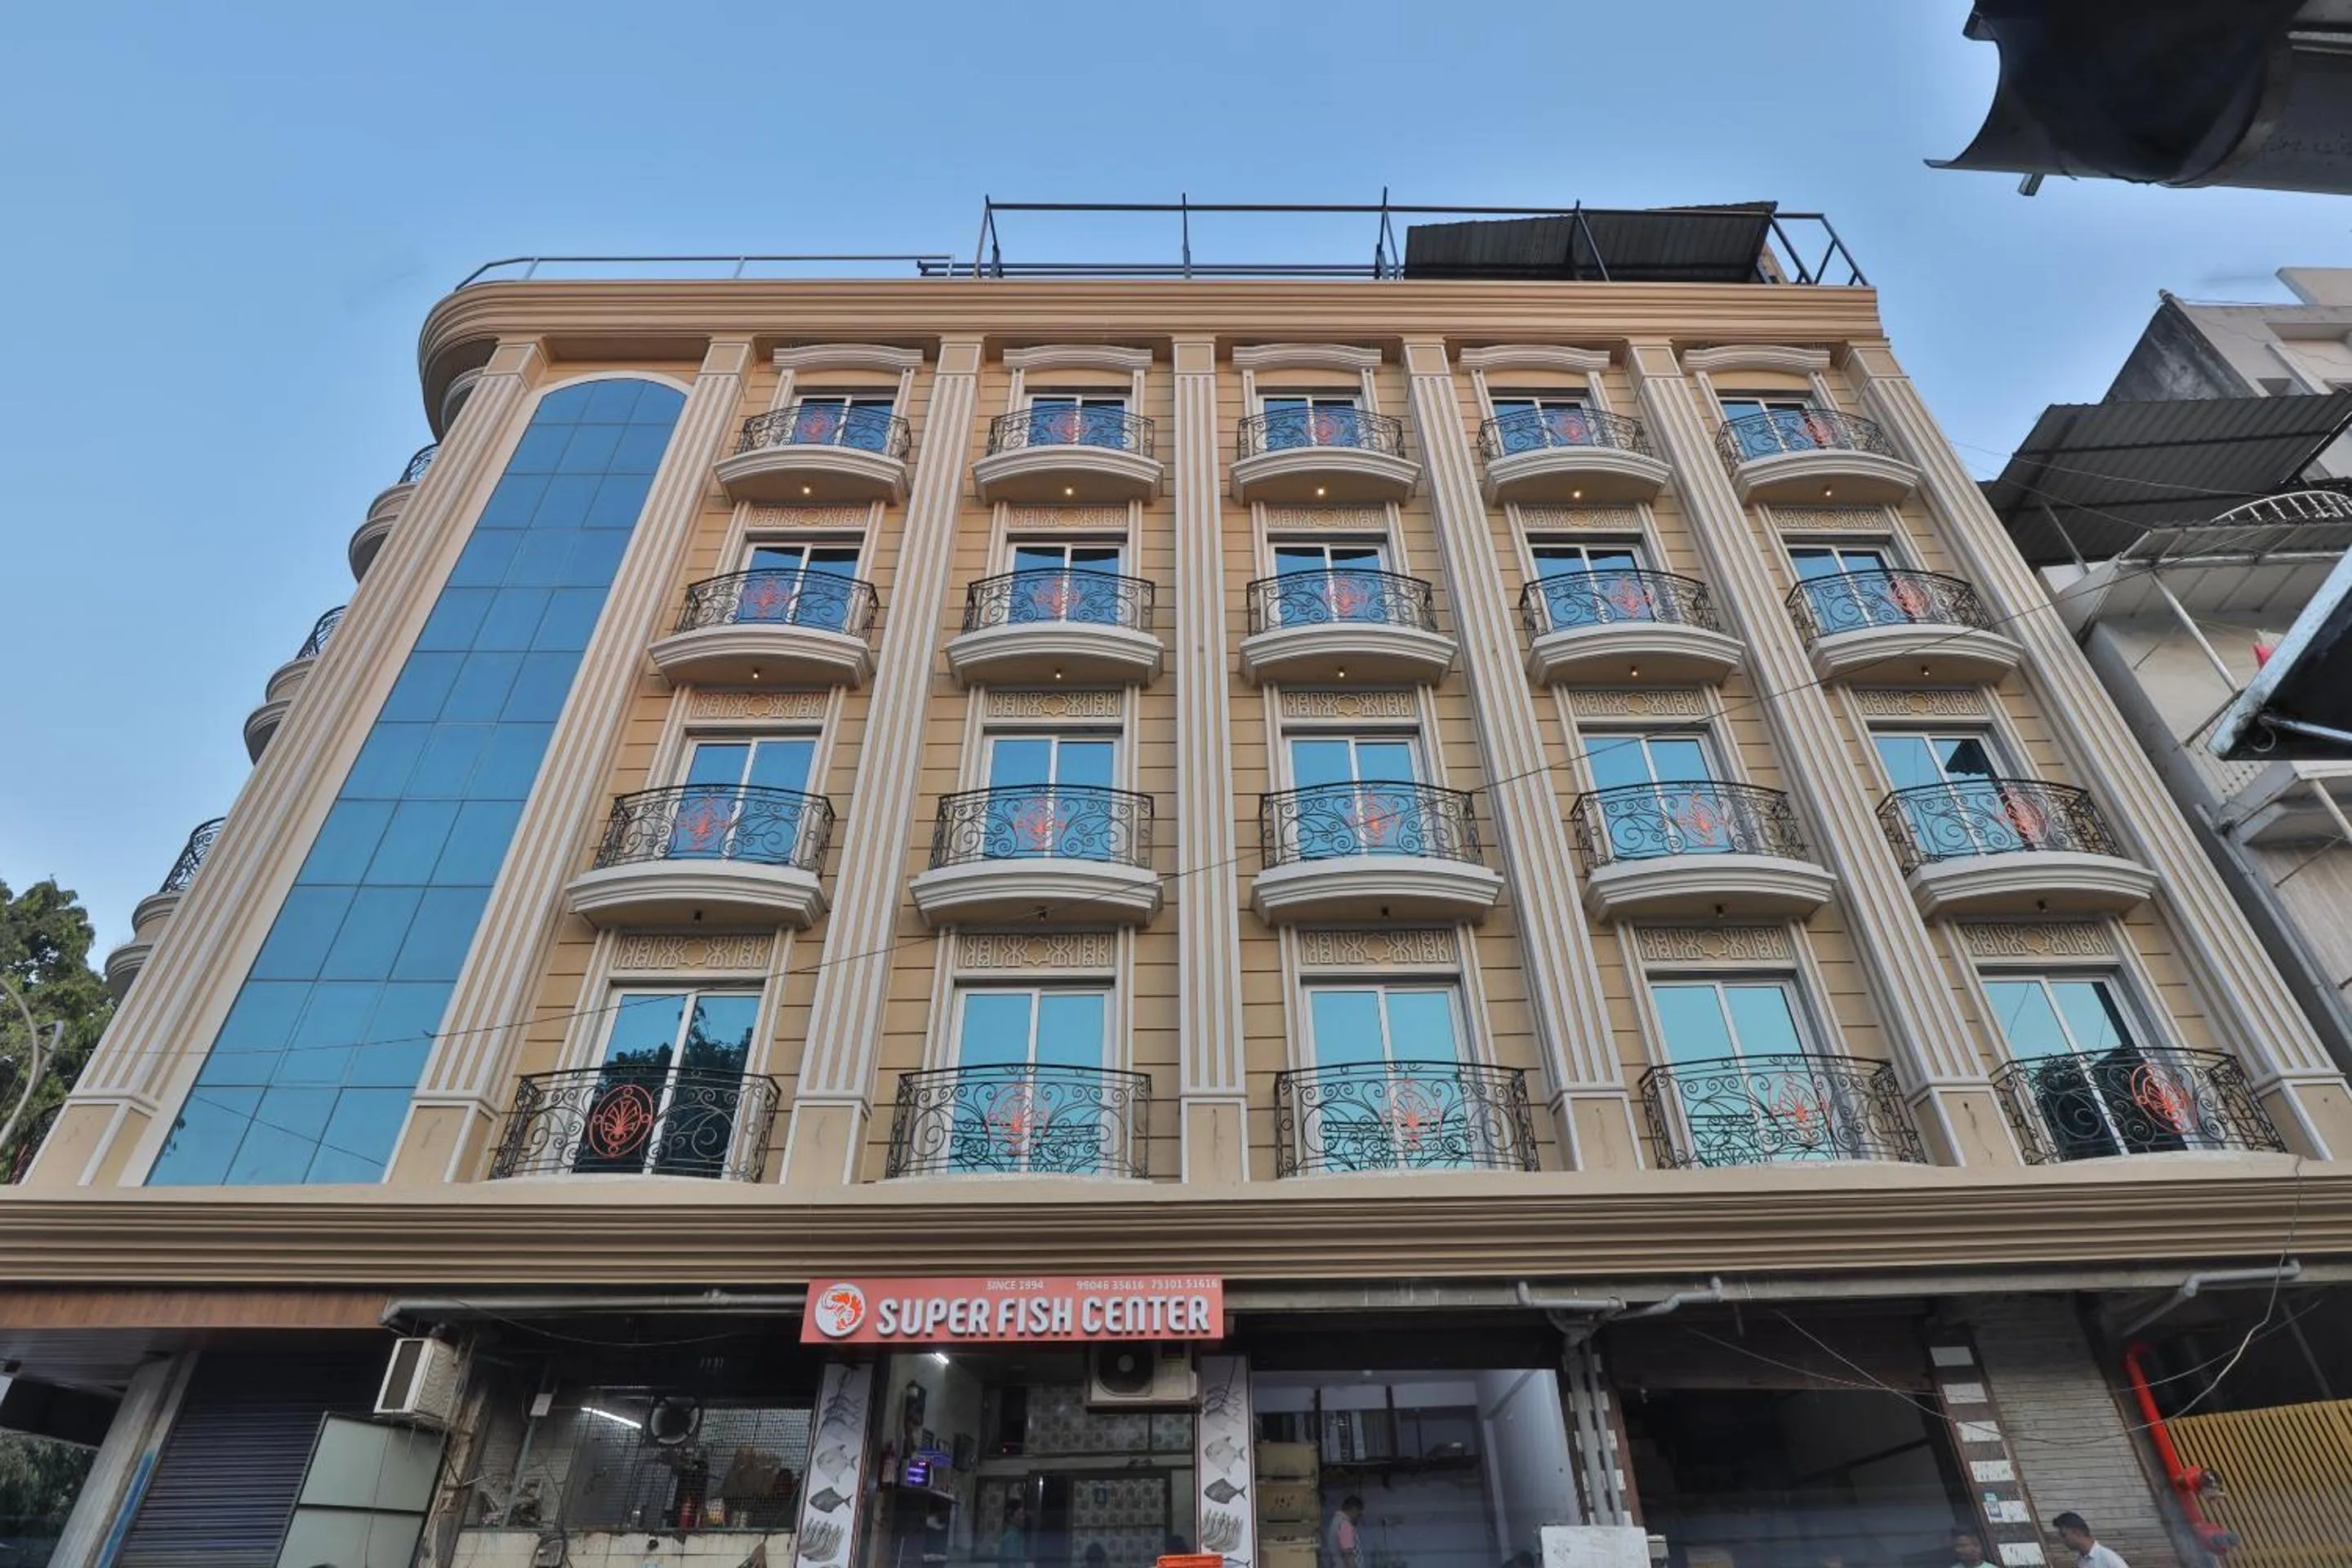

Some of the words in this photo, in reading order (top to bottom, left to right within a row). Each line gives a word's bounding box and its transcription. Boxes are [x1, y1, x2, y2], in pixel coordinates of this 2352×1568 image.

[986, 1280, 1016, 1290] SINCE
[876, 1298, 991, 1335] SUPER
[997, 1296, 1072, 1334] FISH
[1082, 1295, 1210, 1334] CENTER
